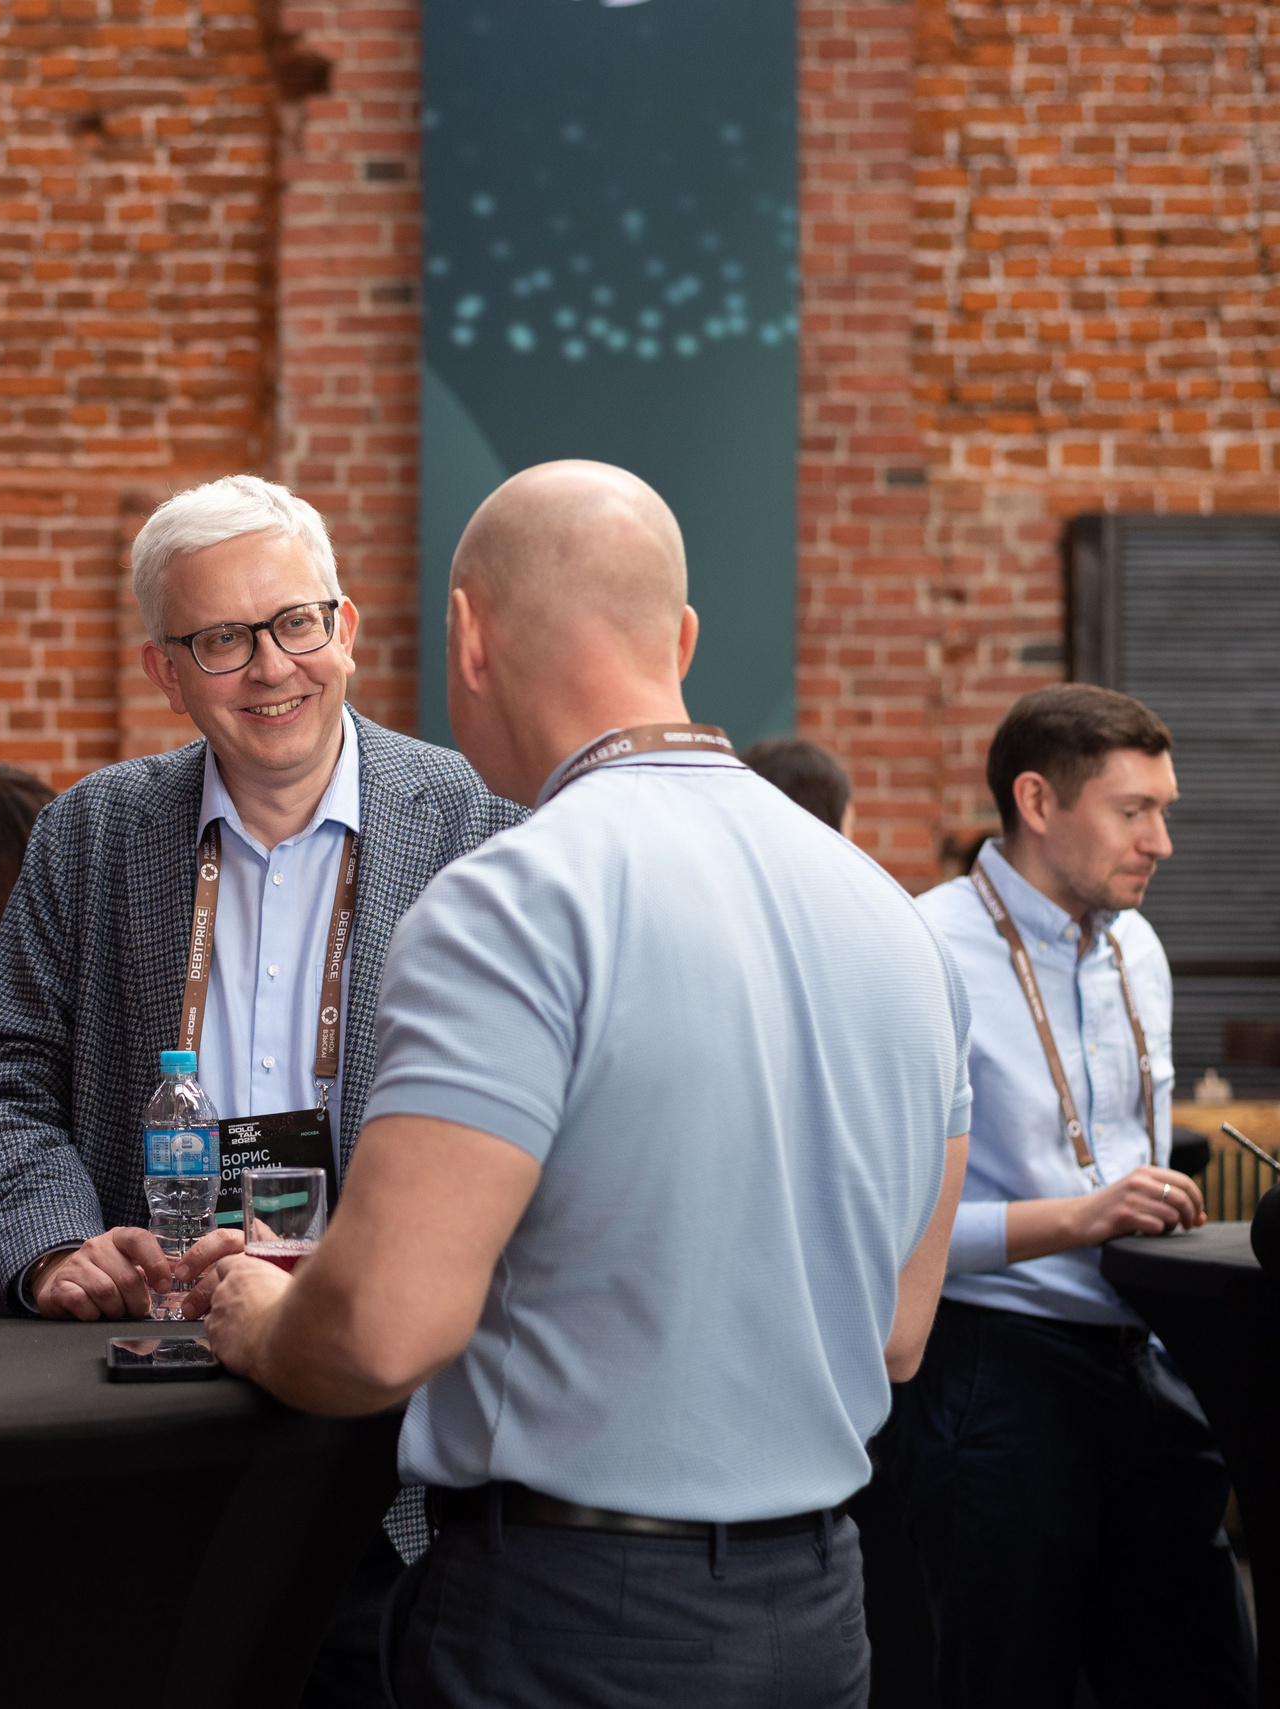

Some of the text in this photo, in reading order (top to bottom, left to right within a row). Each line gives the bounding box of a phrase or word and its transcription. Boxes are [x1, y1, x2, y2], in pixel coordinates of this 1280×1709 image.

[346, 857, 357, 885] 2025
[190, 908, 209, 979] DEBTPRICE
[330, 911, 351, 980] DEBTPRICE
[185, 1006, 197, 1052] LK 2025
[228, 1125, 255, 1135] DOLG
[231, 1136, 257, 1145] 2025
[238, 1130, 262, 1139] TALK
[221, 1149, 270, 1167] БОРИС
